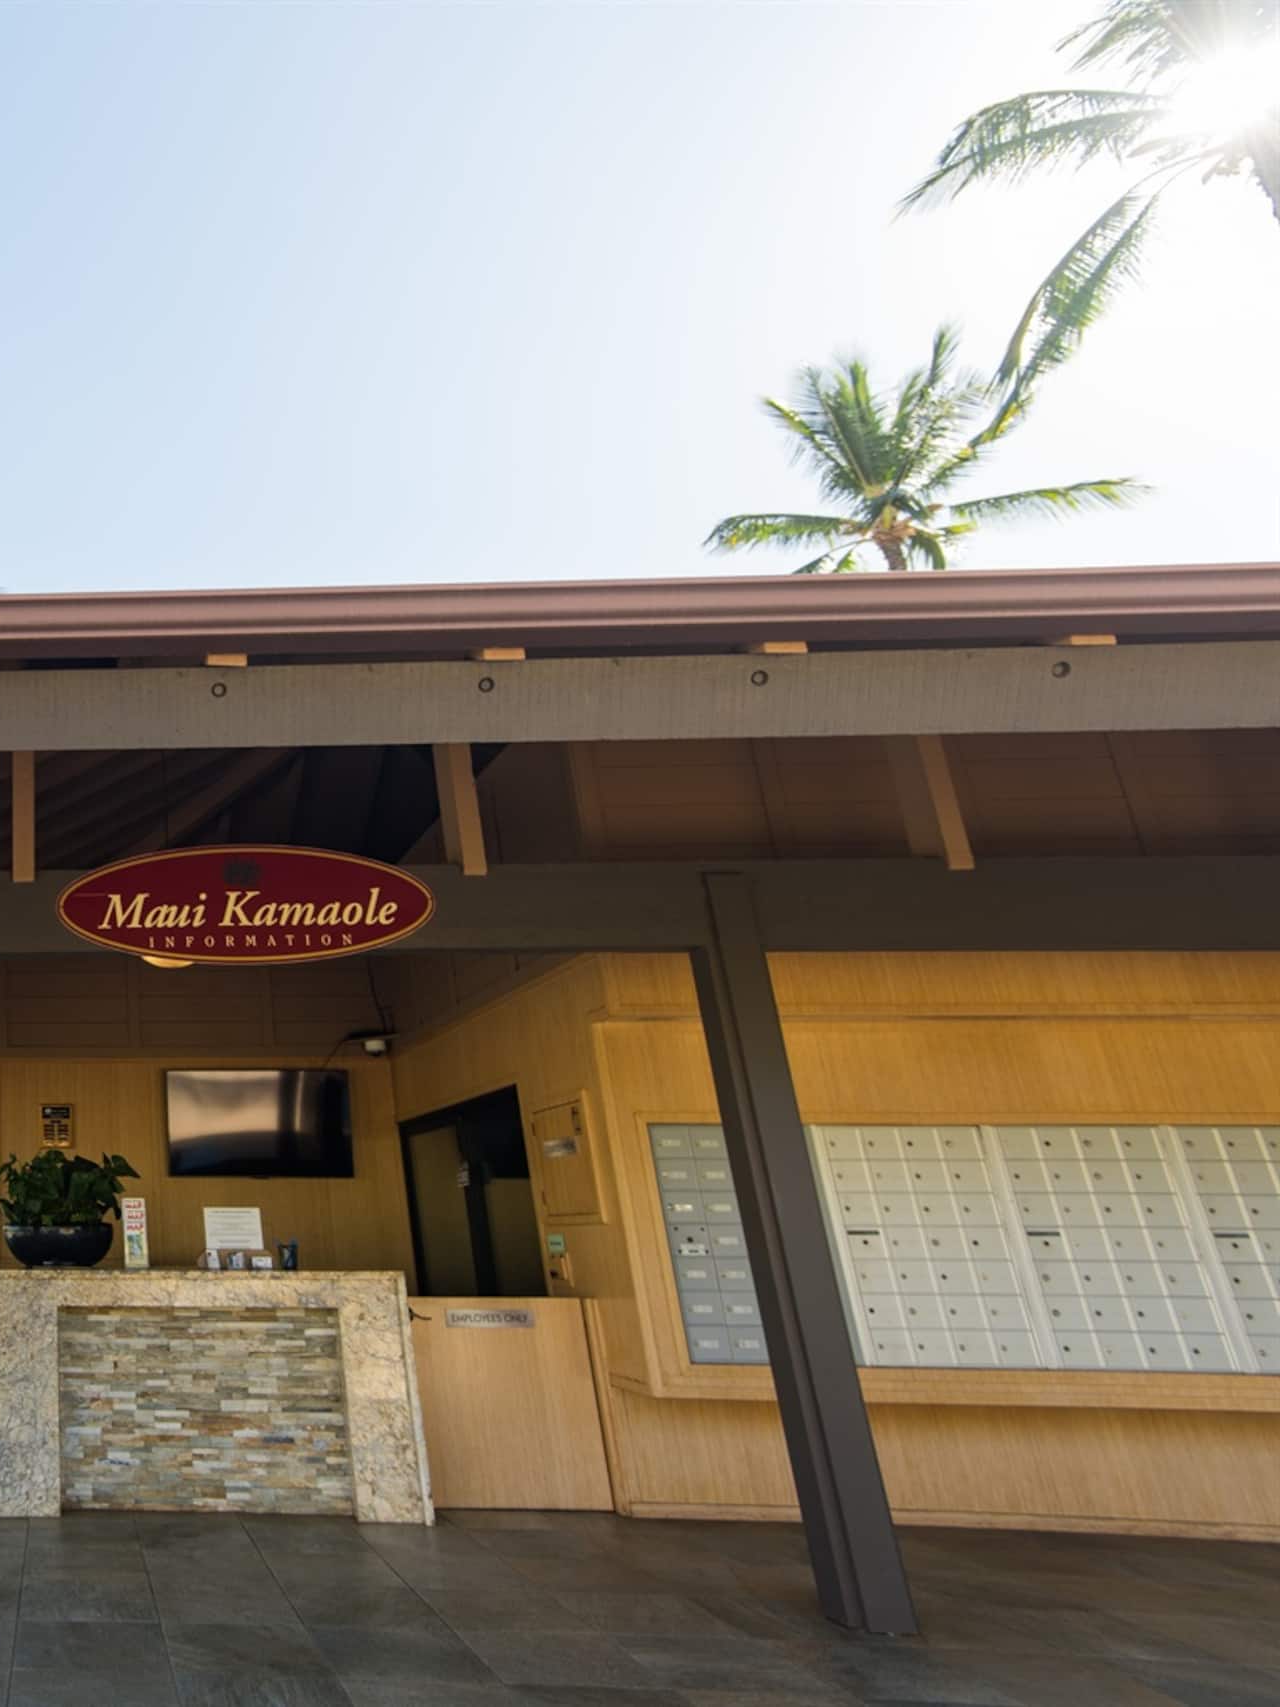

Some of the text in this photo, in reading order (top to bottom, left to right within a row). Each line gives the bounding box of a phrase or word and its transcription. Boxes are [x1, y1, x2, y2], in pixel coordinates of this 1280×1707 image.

[98, 887, 398, 930] Maui Kamaole
[148, 933, 354, 949] INFORMATION
[450, 1312, 528, 1324] EMPLOYEES ONLY
